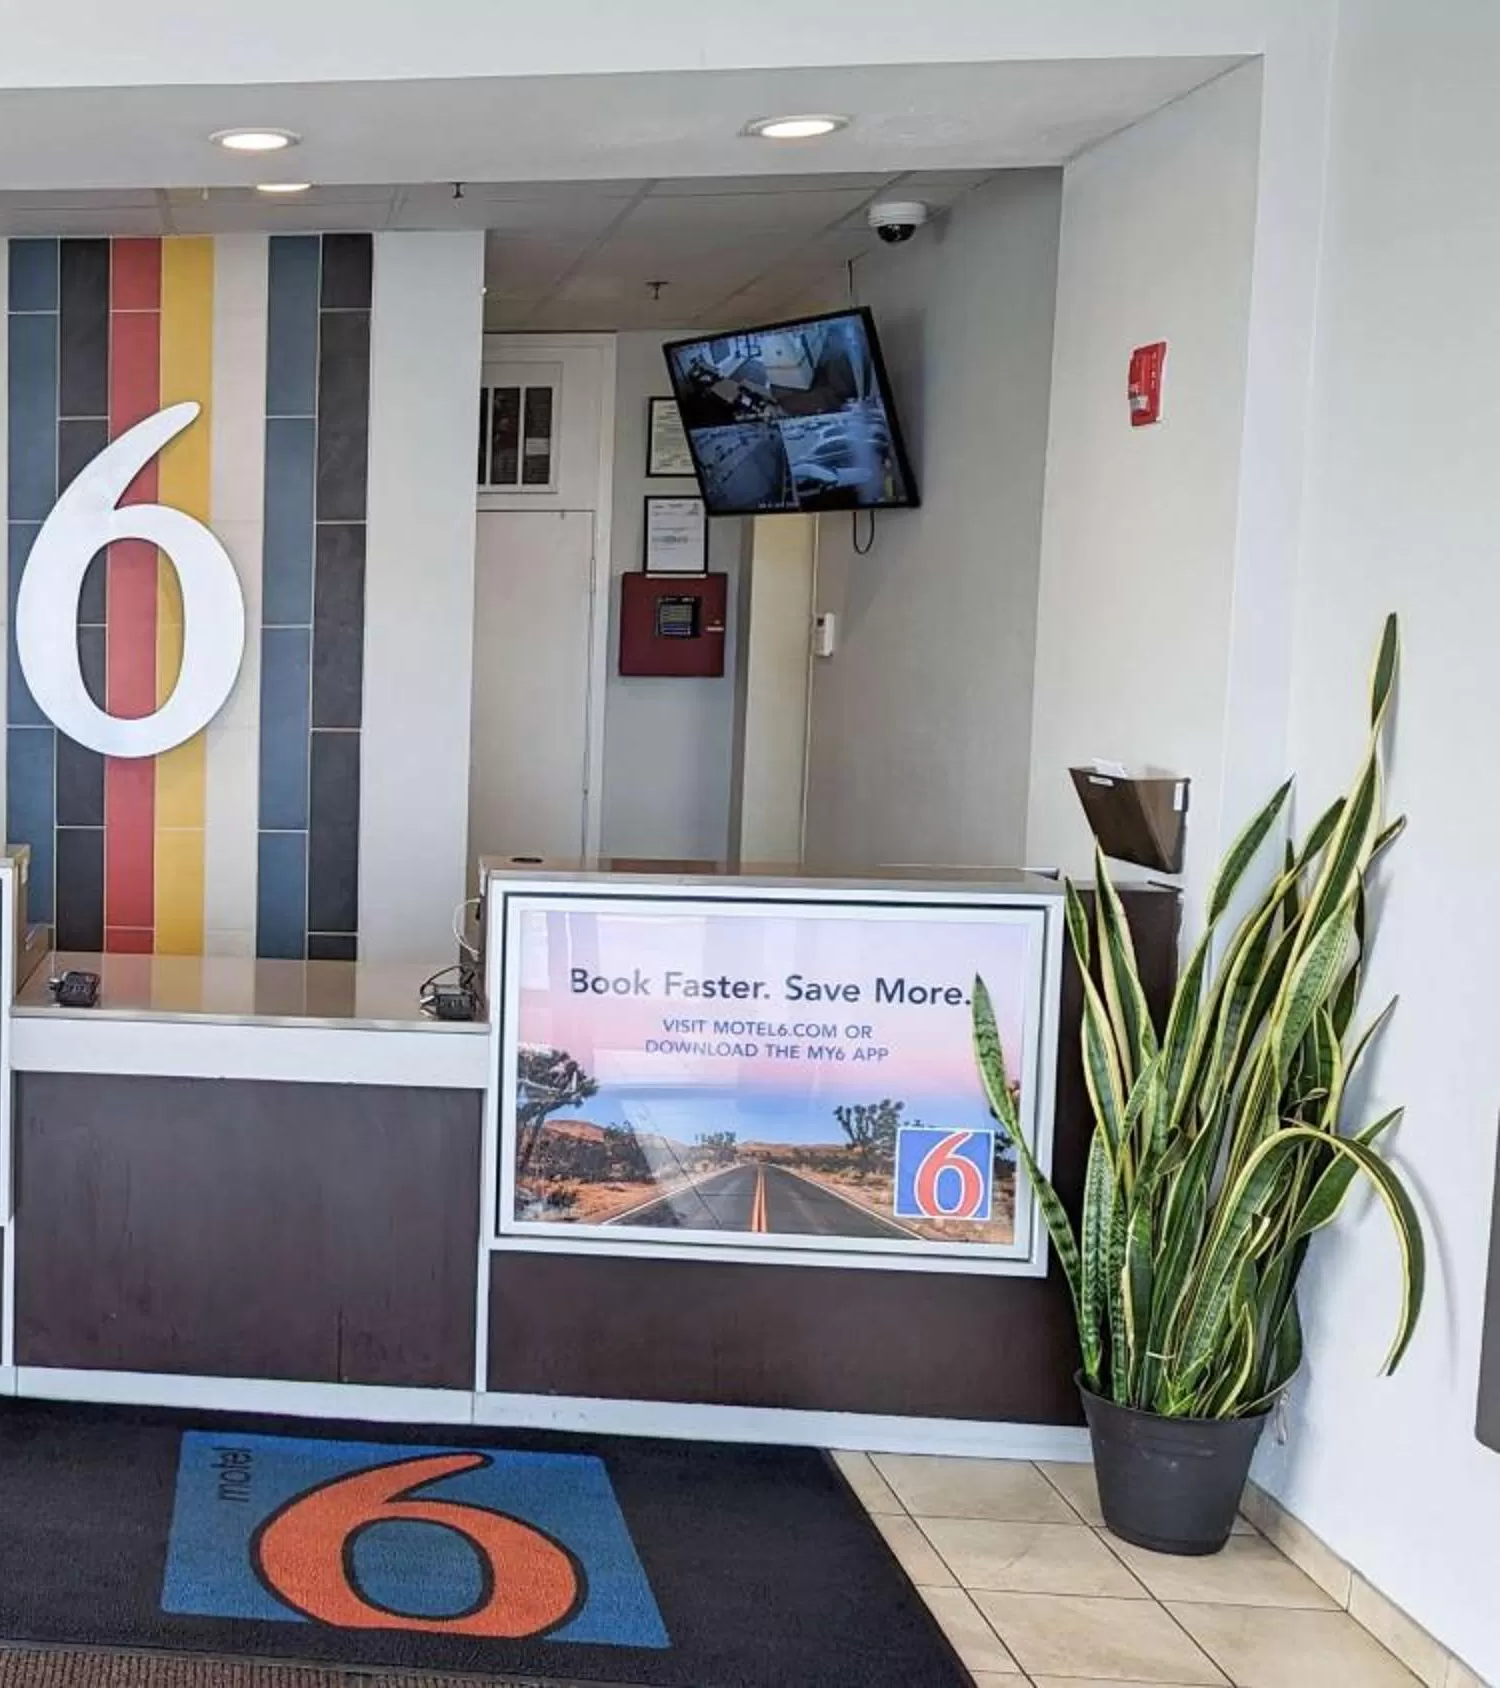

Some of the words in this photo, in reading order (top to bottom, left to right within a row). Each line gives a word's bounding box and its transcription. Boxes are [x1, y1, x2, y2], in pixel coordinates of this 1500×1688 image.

[16, 401, 245, 758] 6
[571, 967, 651, 996] Book
[664, 971, 770, 999] Faster.
[785, 974, 861, 1002] Save
[875, 977, 971, 1006] More.
[645, 1039, 758, 1057] DOWNLOAD
[765, 1044, 800, 1059] THE
[807, 1046, 845, 1061] MY6
[852, 1047, 889, 1061] APP
[663, 1019, 707, 1034] VISIT
[713, 1021, 837, 1038] MOTEL6.COM
[845, 1025, 873, 1039] OR
[913, 1131, 986, 1218] 6
[211, 1447, 253, 1503] motel
[249, 1451, 588, 1638] 6
